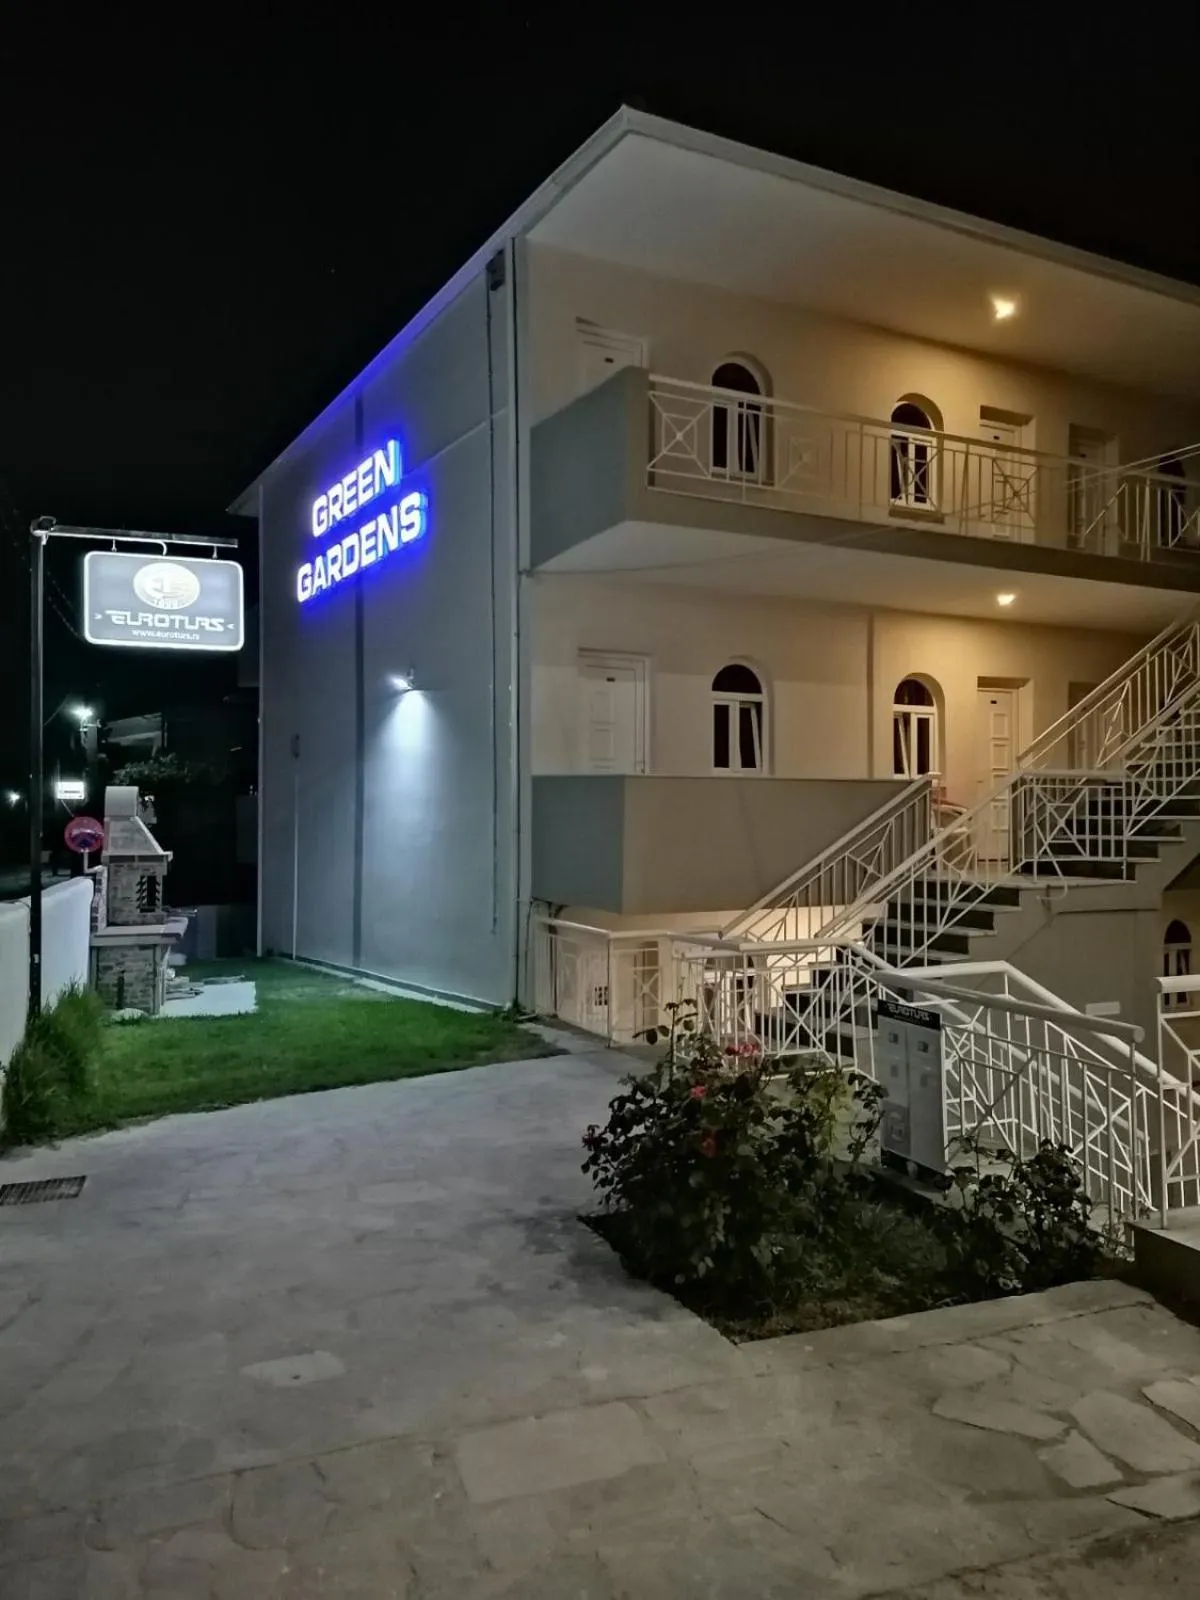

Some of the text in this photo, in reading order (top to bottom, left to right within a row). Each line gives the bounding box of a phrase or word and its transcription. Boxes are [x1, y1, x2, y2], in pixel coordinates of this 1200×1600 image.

[312, 439, 401, 537] GREEN
[297, 491, 426, 602] GARDENS
[105, 609, 225, 632] EUROTURS
